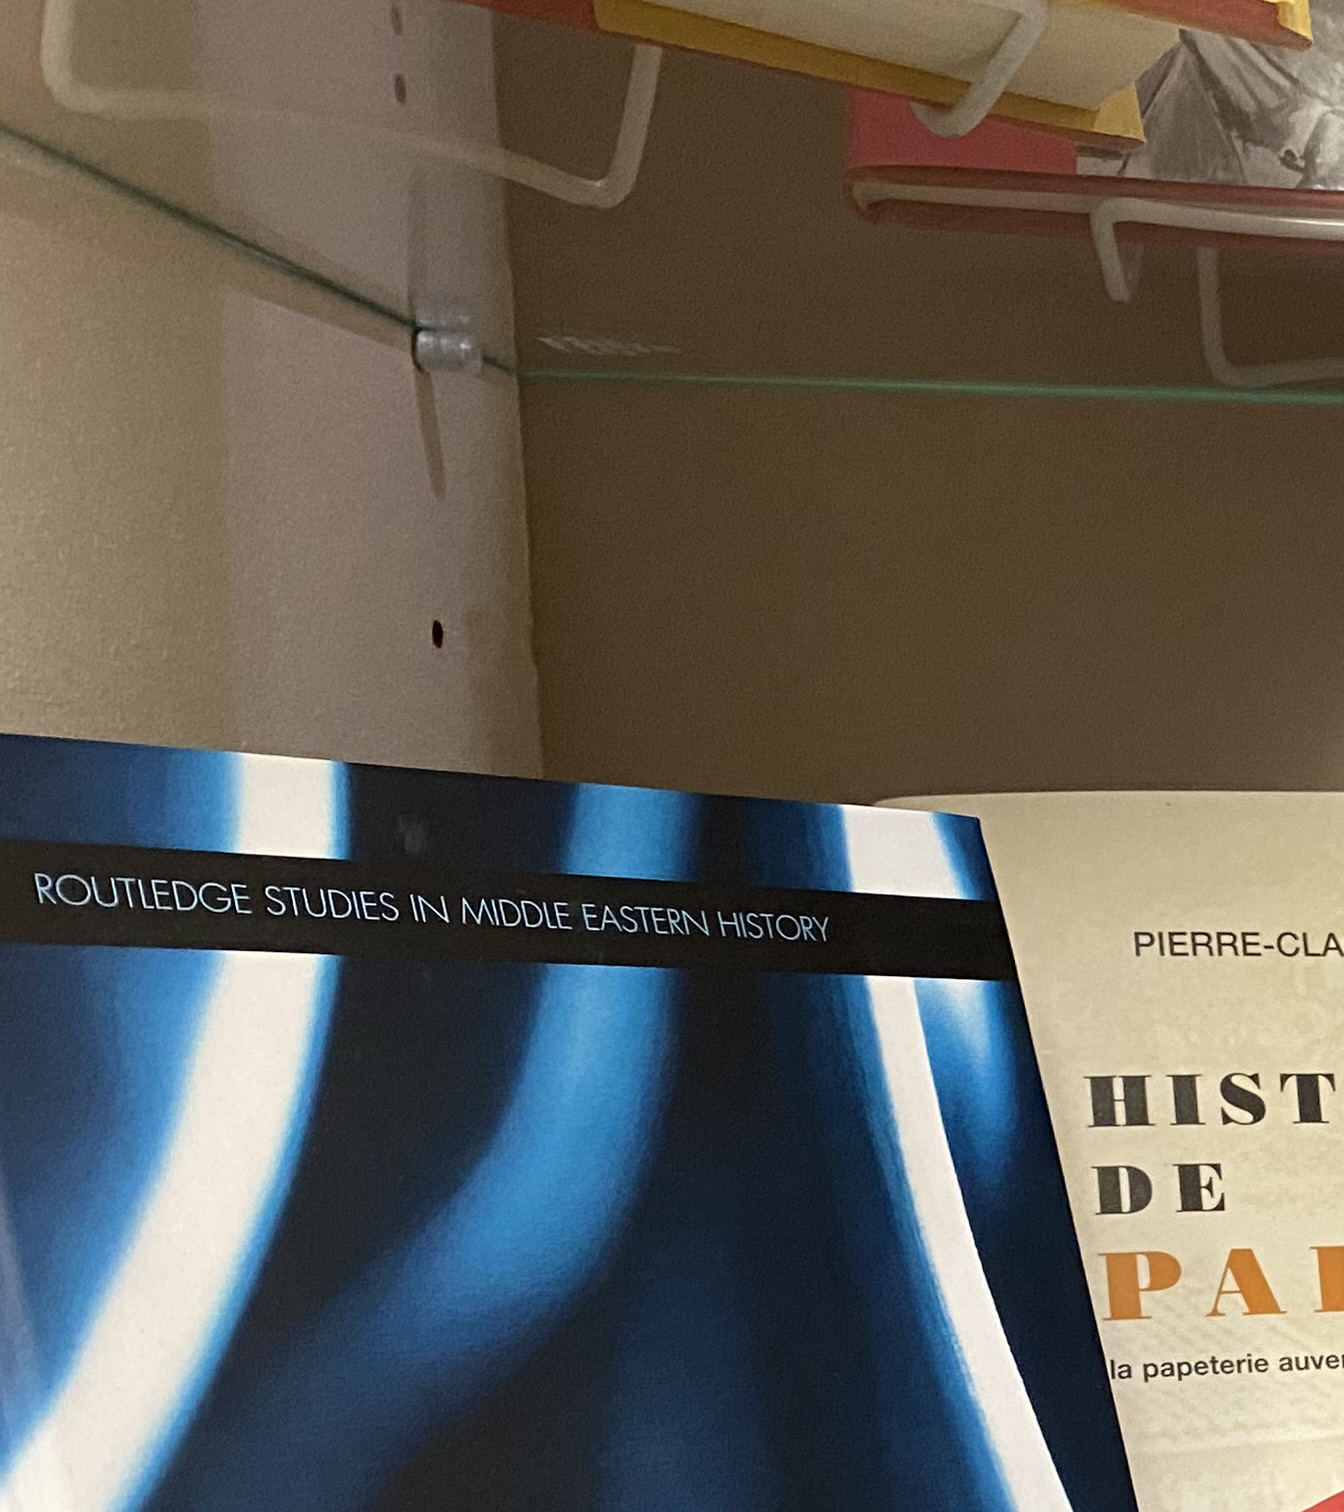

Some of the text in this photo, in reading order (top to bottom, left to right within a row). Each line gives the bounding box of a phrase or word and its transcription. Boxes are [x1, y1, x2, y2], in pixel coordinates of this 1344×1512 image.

[34, 872, 830, 942] ROUTLEDGE STUDIES IN MIDDLE EASTERN HISTORY
[1091, 1163, 1226, 1215] DE
[1110, 1358, 1132, 1380] la
[1142, 1351, 1269, 1382] papeterie
